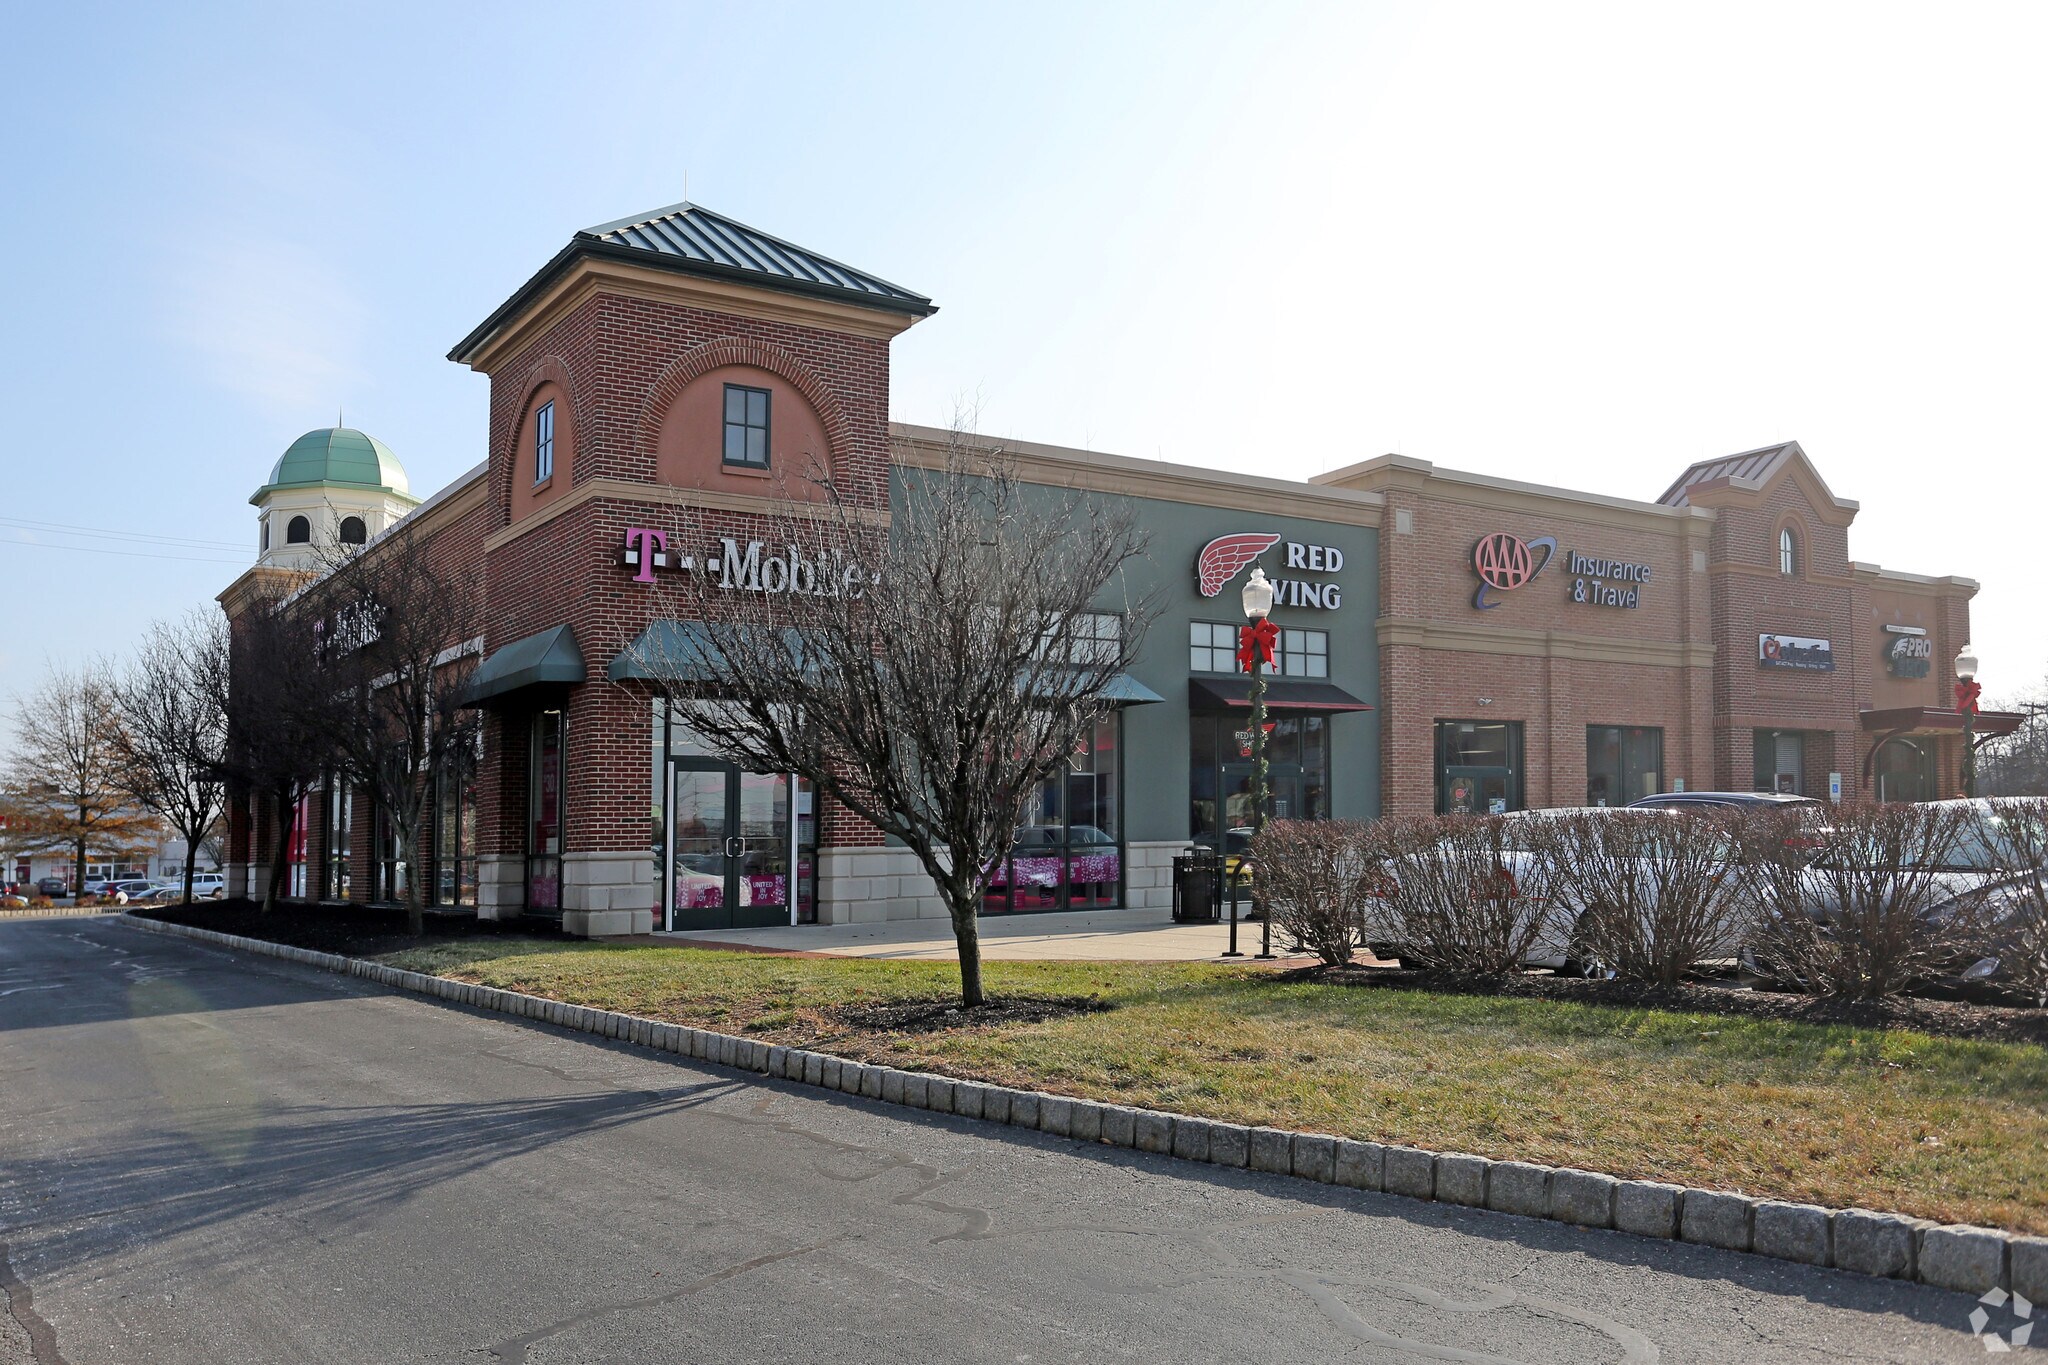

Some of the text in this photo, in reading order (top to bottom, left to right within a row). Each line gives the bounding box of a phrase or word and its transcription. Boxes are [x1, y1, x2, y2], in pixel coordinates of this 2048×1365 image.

[1287, 542, 1344, 573] RED
[1482, 534, 1528, 588] AAA
[1570, 550, 1651, 583] Insurance
[1574, 578, 1641, 609] & Travel
[1907, 638, 1932, 658] PRO
